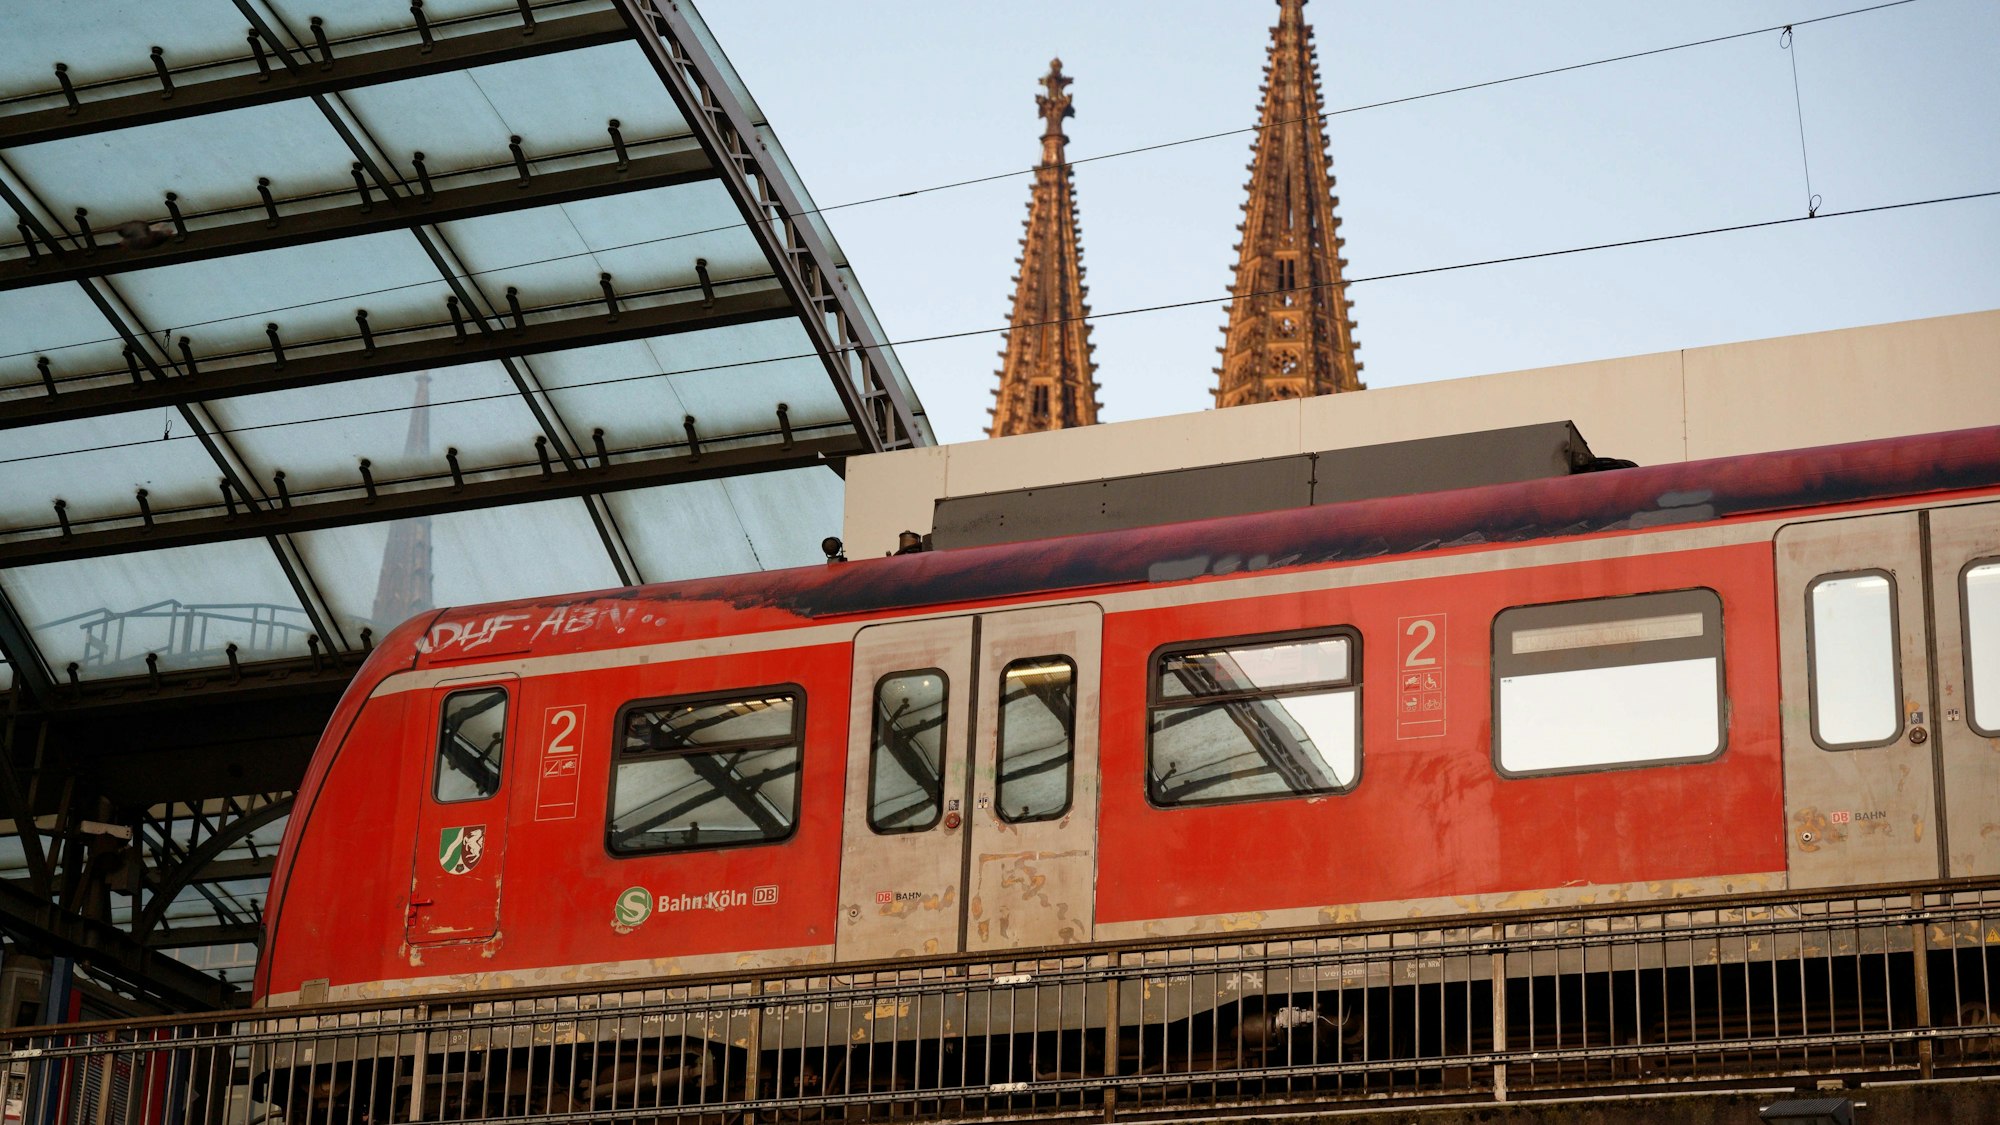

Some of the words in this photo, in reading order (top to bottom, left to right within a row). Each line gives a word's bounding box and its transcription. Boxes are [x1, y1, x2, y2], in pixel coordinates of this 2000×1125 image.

[1405, 619, 1436, 667] 2
[547, 710, 576, 754] 2
[1832, 811, 1849, 824] DB
[1854, 810, 1887, 821] BAHN
[621, 890, 648, 924] S
[658, 893, 702, 913] Bahn
[706, 889, 747, 910] Köln
[753, 885, 779, 906] DB
[876, 891, 892, 904] DB
[895, 891, 922, 901] BAHN
